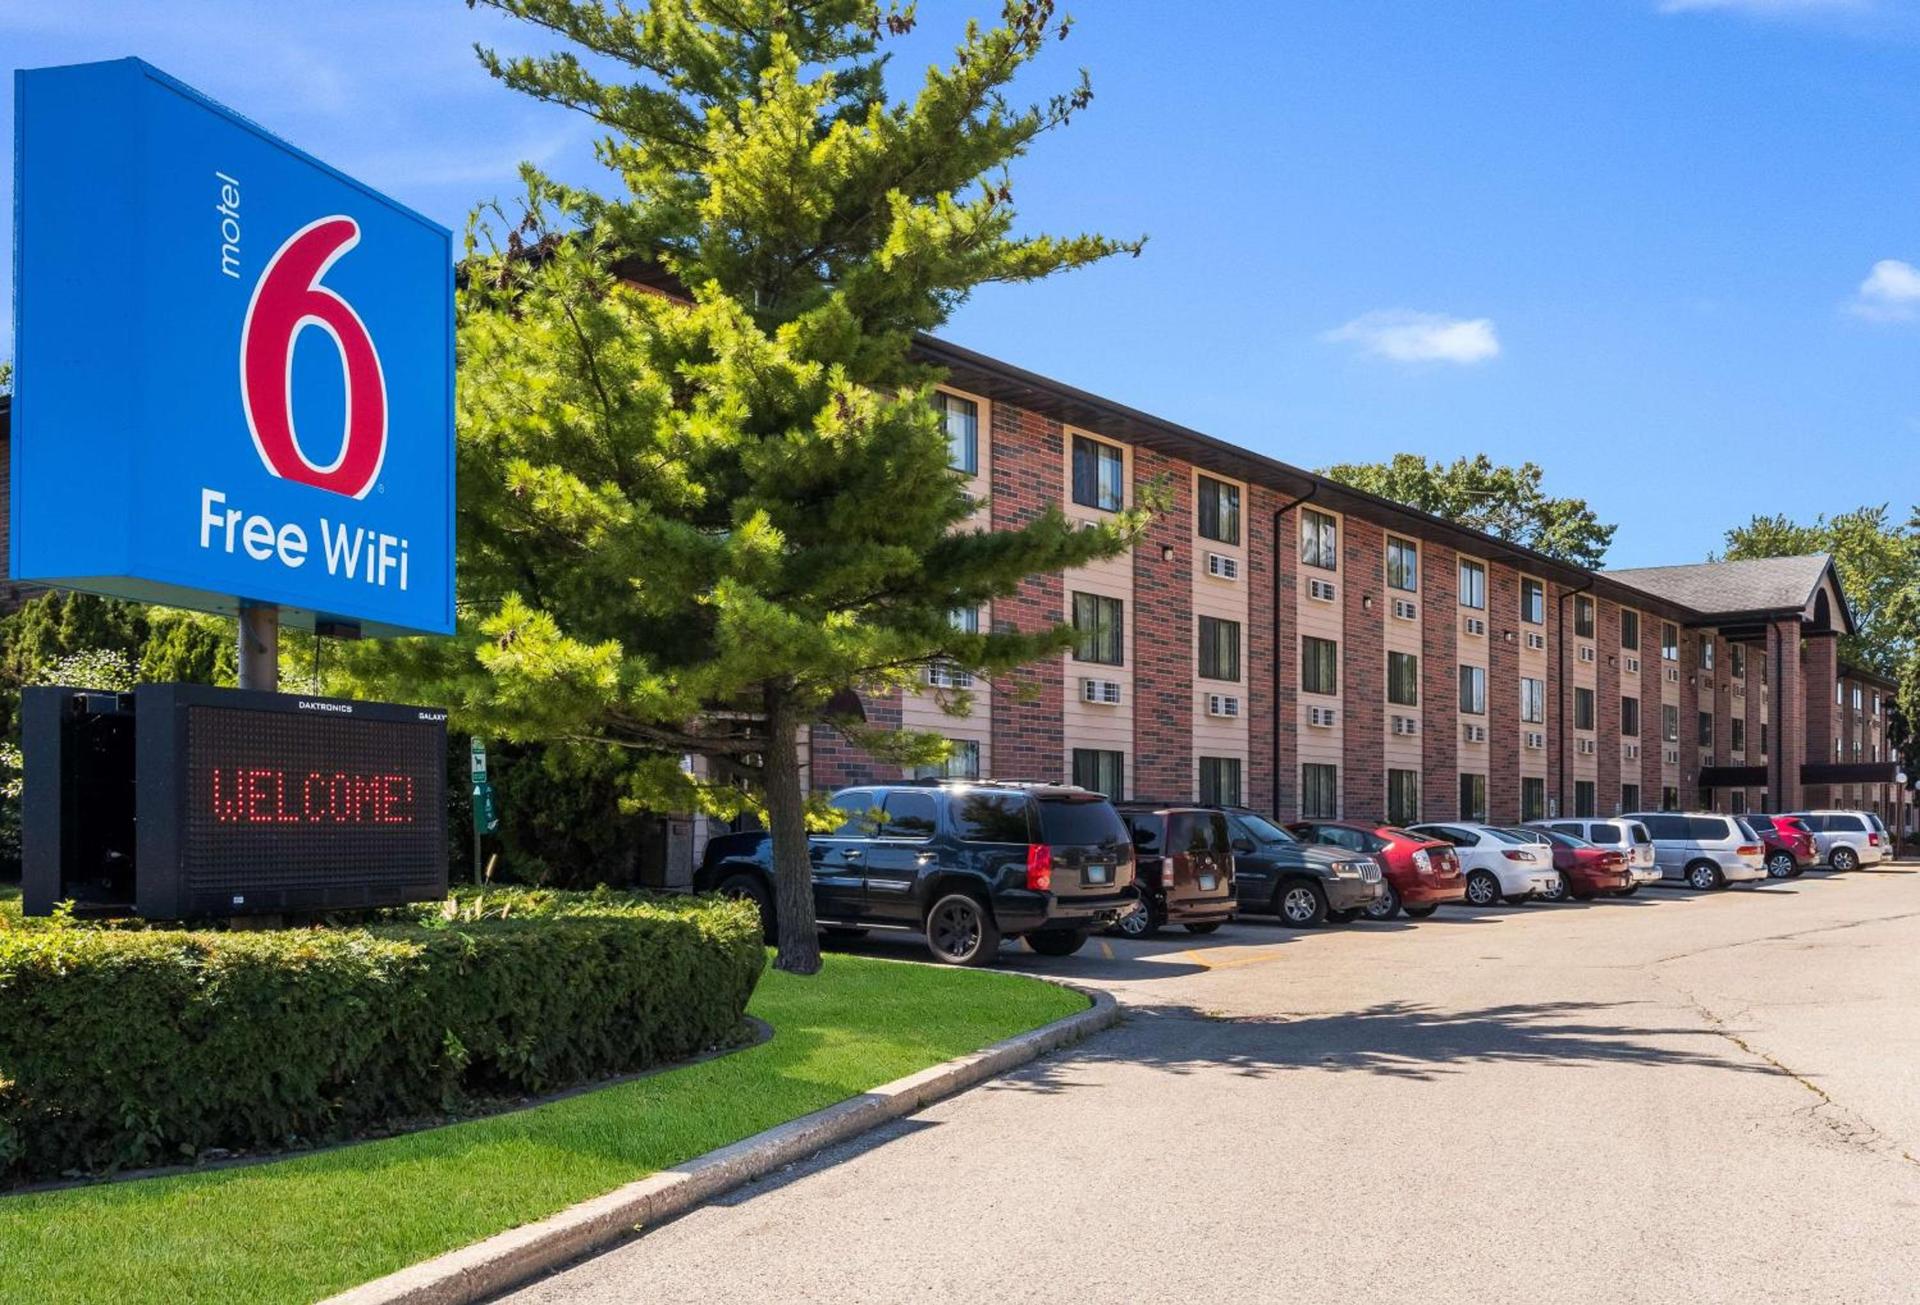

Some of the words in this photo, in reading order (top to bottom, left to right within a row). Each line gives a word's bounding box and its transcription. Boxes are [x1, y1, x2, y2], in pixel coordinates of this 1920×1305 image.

[216, 171, 240, 279] motel
[239, 214, 389, 501] 6
[200, 487, 308, 568] Free
[320, 518, 409, 591] WiFi
[298, 701, 353, 713] DAKTRONICS
[418, 712, 447, 721] GALAXY
[213, 768, 413, 823] WELCOME!
